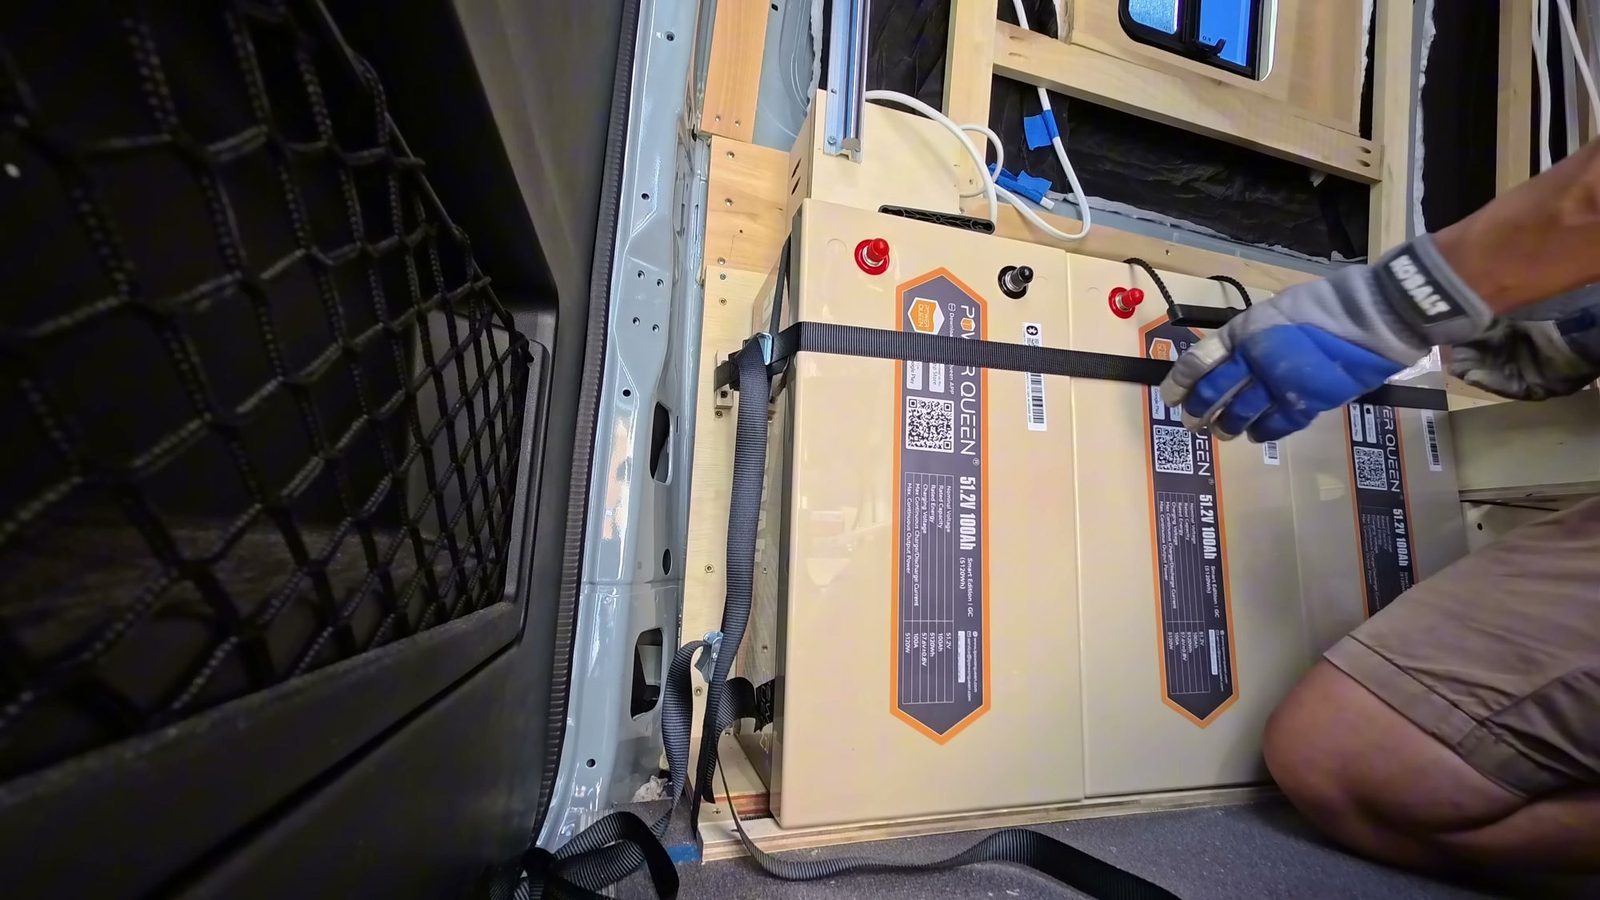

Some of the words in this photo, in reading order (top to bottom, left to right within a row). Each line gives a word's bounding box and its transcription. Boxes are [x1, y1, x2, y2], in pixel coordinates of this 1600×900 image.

[1388, 255, 1451, 316] KOBALT
[960, 381, 976, 455] QUEEN
[1385, 434, 1400, 492] QUEEN
[960, 476, 976, 509] 51.2V
[1199, 494, 1214, 524] 51.2V
[1393, 508, 1405, 534] 51.2V
[960, 513, 976, 550] 100Ah
[1201, 527, 1217, 559] 100Ah
[1396, 538, 1409, 566] 100Ah
[968, 607, 973, 617] GC
[1214, 609, 1220, 618] GC
